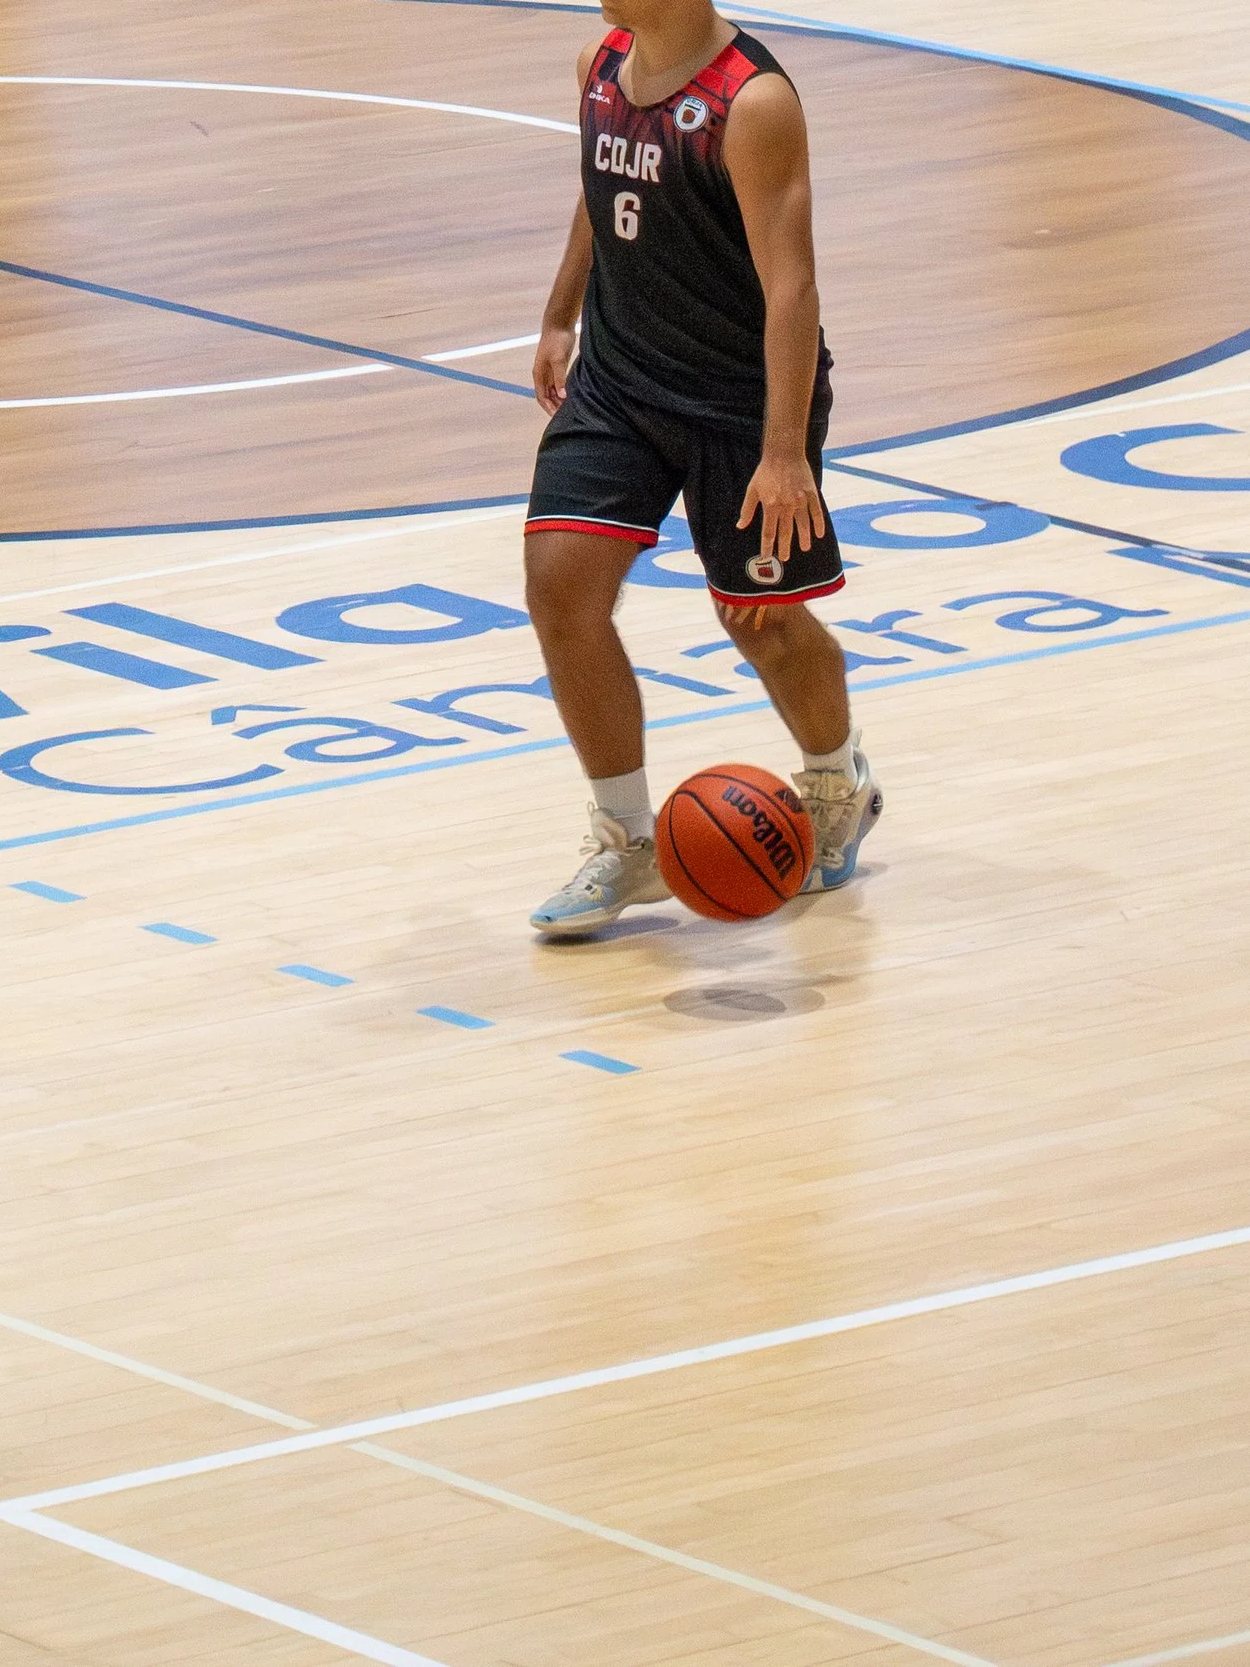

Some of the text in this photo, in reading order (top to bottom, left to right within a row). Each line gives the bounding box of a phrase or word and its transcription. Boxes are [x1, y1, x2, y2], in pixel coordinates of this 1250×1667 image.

[594, 132, 663, 183] CDJR
[614, 191, 641, 241] 6
[721, 785, 797, 882] Wilson
